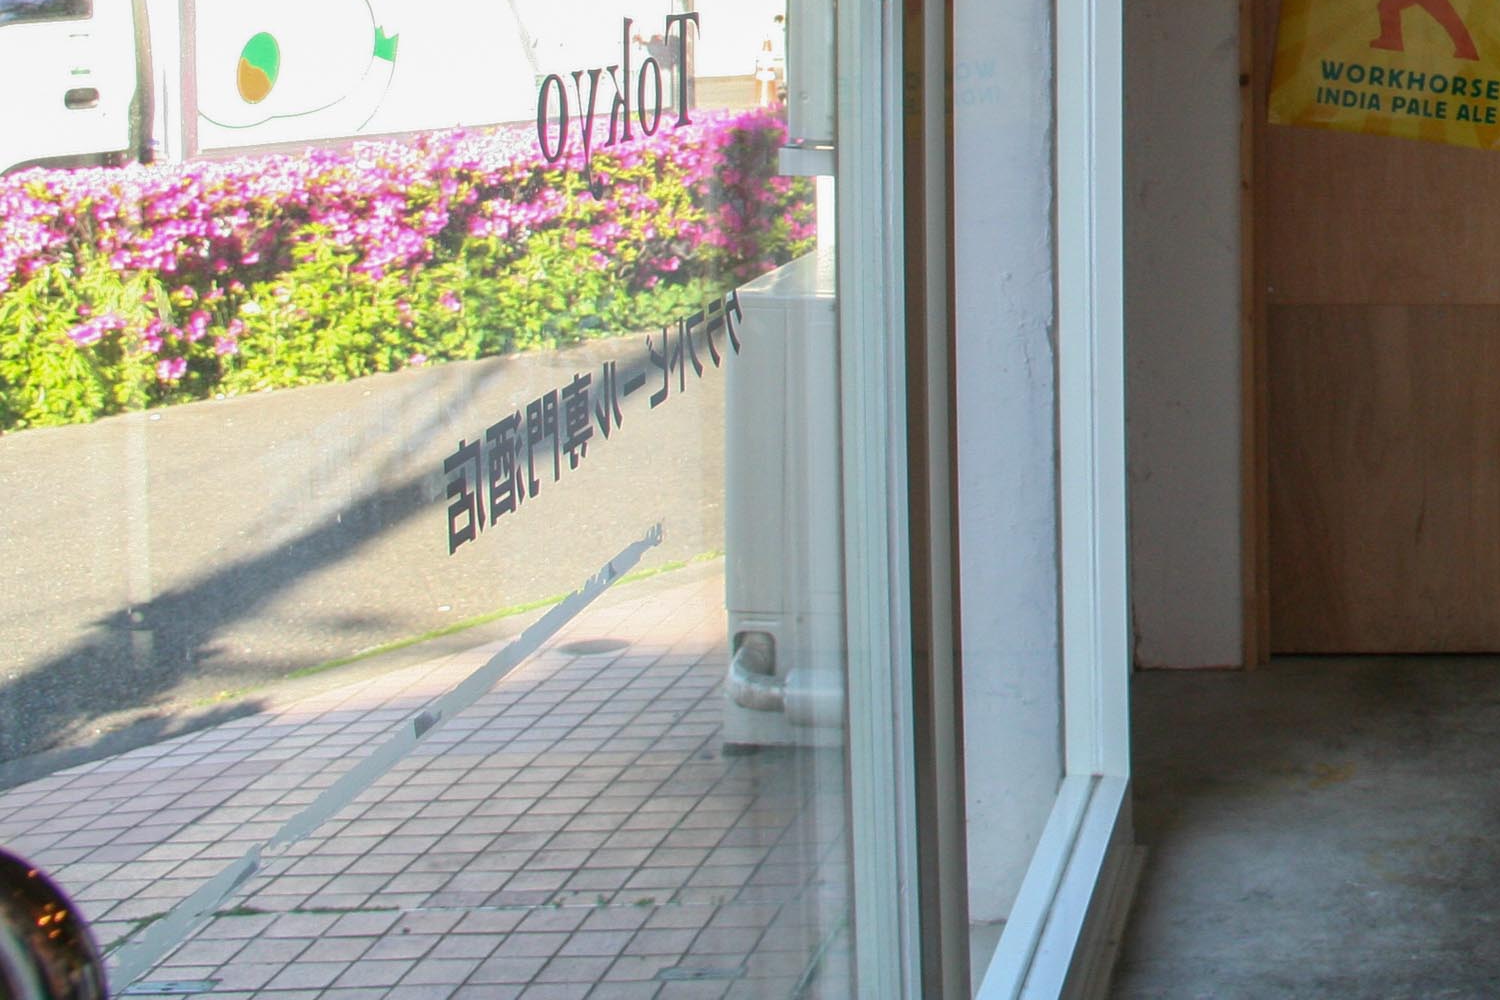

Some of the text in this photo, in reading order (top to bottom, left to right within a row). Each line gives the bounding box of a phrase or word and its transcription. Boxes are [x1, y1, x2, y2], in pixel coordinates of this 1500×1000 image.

[1320, 60, 1500, 101] WORKHORSE
[1316, 86, 1497, 125] INDIA PALE ALE
